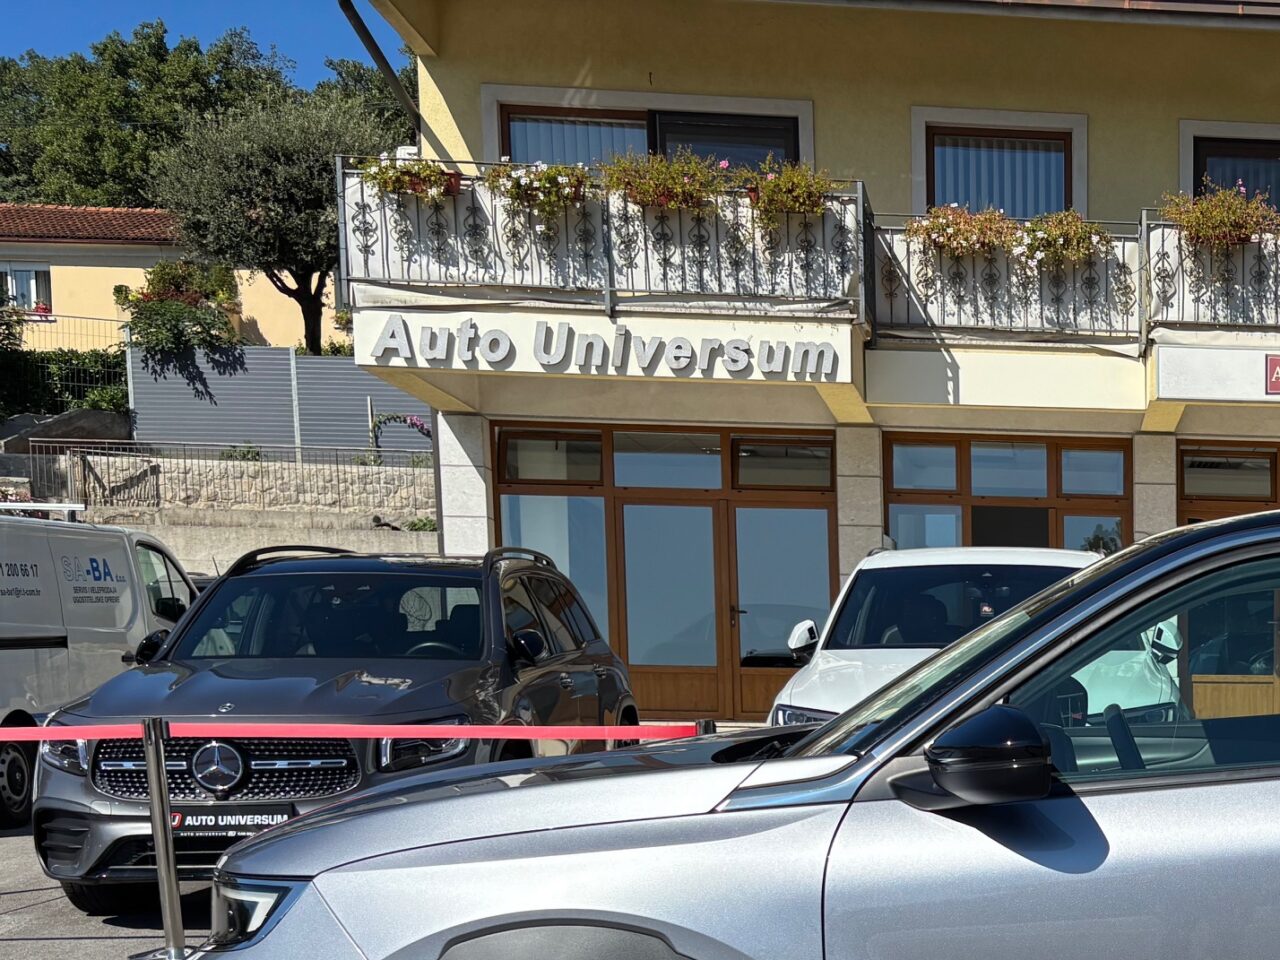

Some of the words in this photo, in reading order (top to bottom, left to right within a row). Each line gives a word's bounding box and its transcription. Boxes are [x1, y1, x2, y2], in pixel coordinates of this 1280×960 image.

[371, 314, 511, 363] Auto
[535, 320, 834, 375] Universum
[61, 555, 114, 582] SA-BA
[185, 815, 216, 826] AUTO
[218, 814, 289, 826] UNIVERSUM
